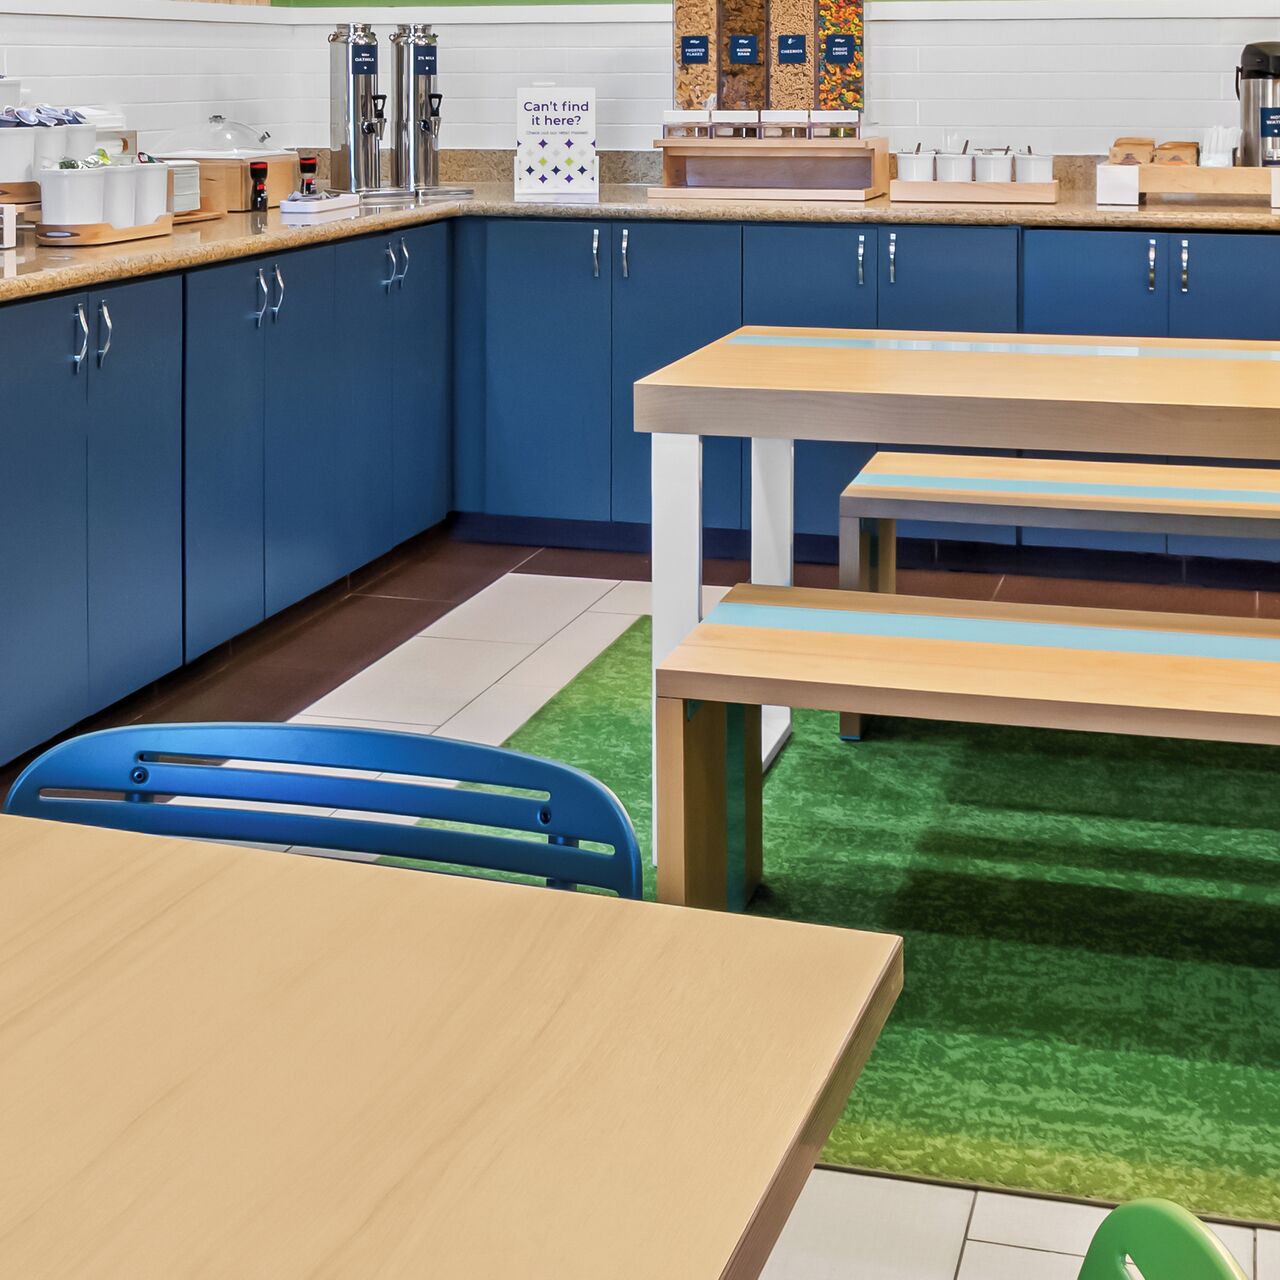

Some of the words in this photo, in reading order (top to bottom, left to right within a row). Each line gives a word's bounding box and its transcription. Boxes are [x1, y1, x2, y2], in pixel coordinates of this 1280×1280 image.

[523, 101, 558, 112] Can't
[562, 101, 589, 111] find
[531, 115, 540, 125] it
[544, 115, 581, 125] here?
